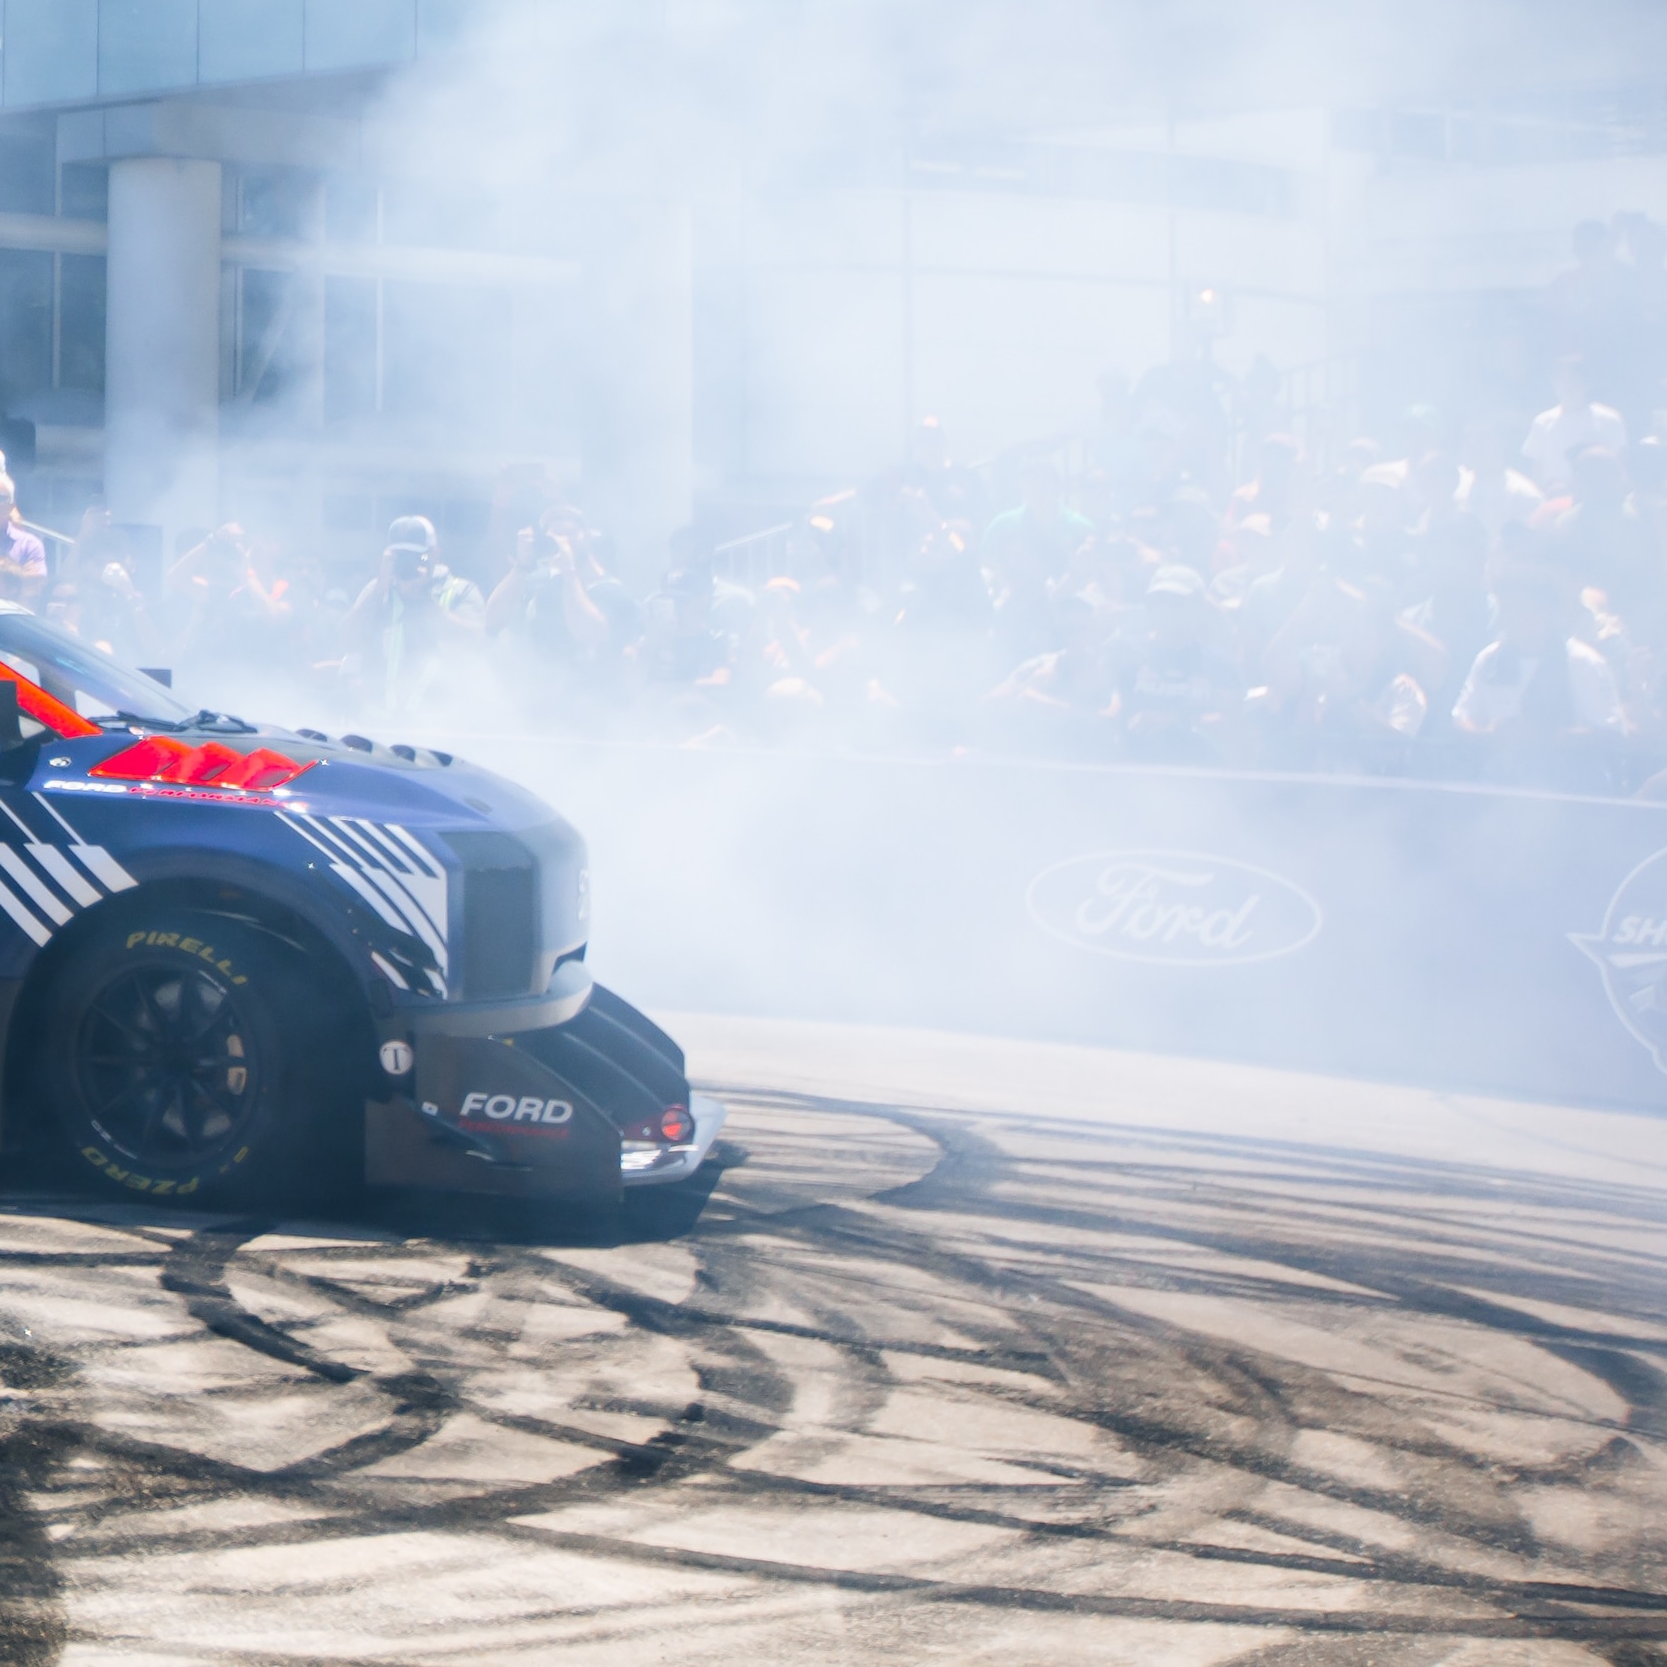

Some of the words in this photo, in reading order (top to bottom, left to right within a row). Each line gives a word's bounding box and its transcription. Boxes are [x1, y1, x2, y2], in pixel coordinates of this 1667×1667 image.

[43, 779, 127, 793] FORD
[1075, 863, 1262, 948] Ford
[126, 930, 249, 985] PIRELLI
[460, 1092, 574, 1124] FORD
